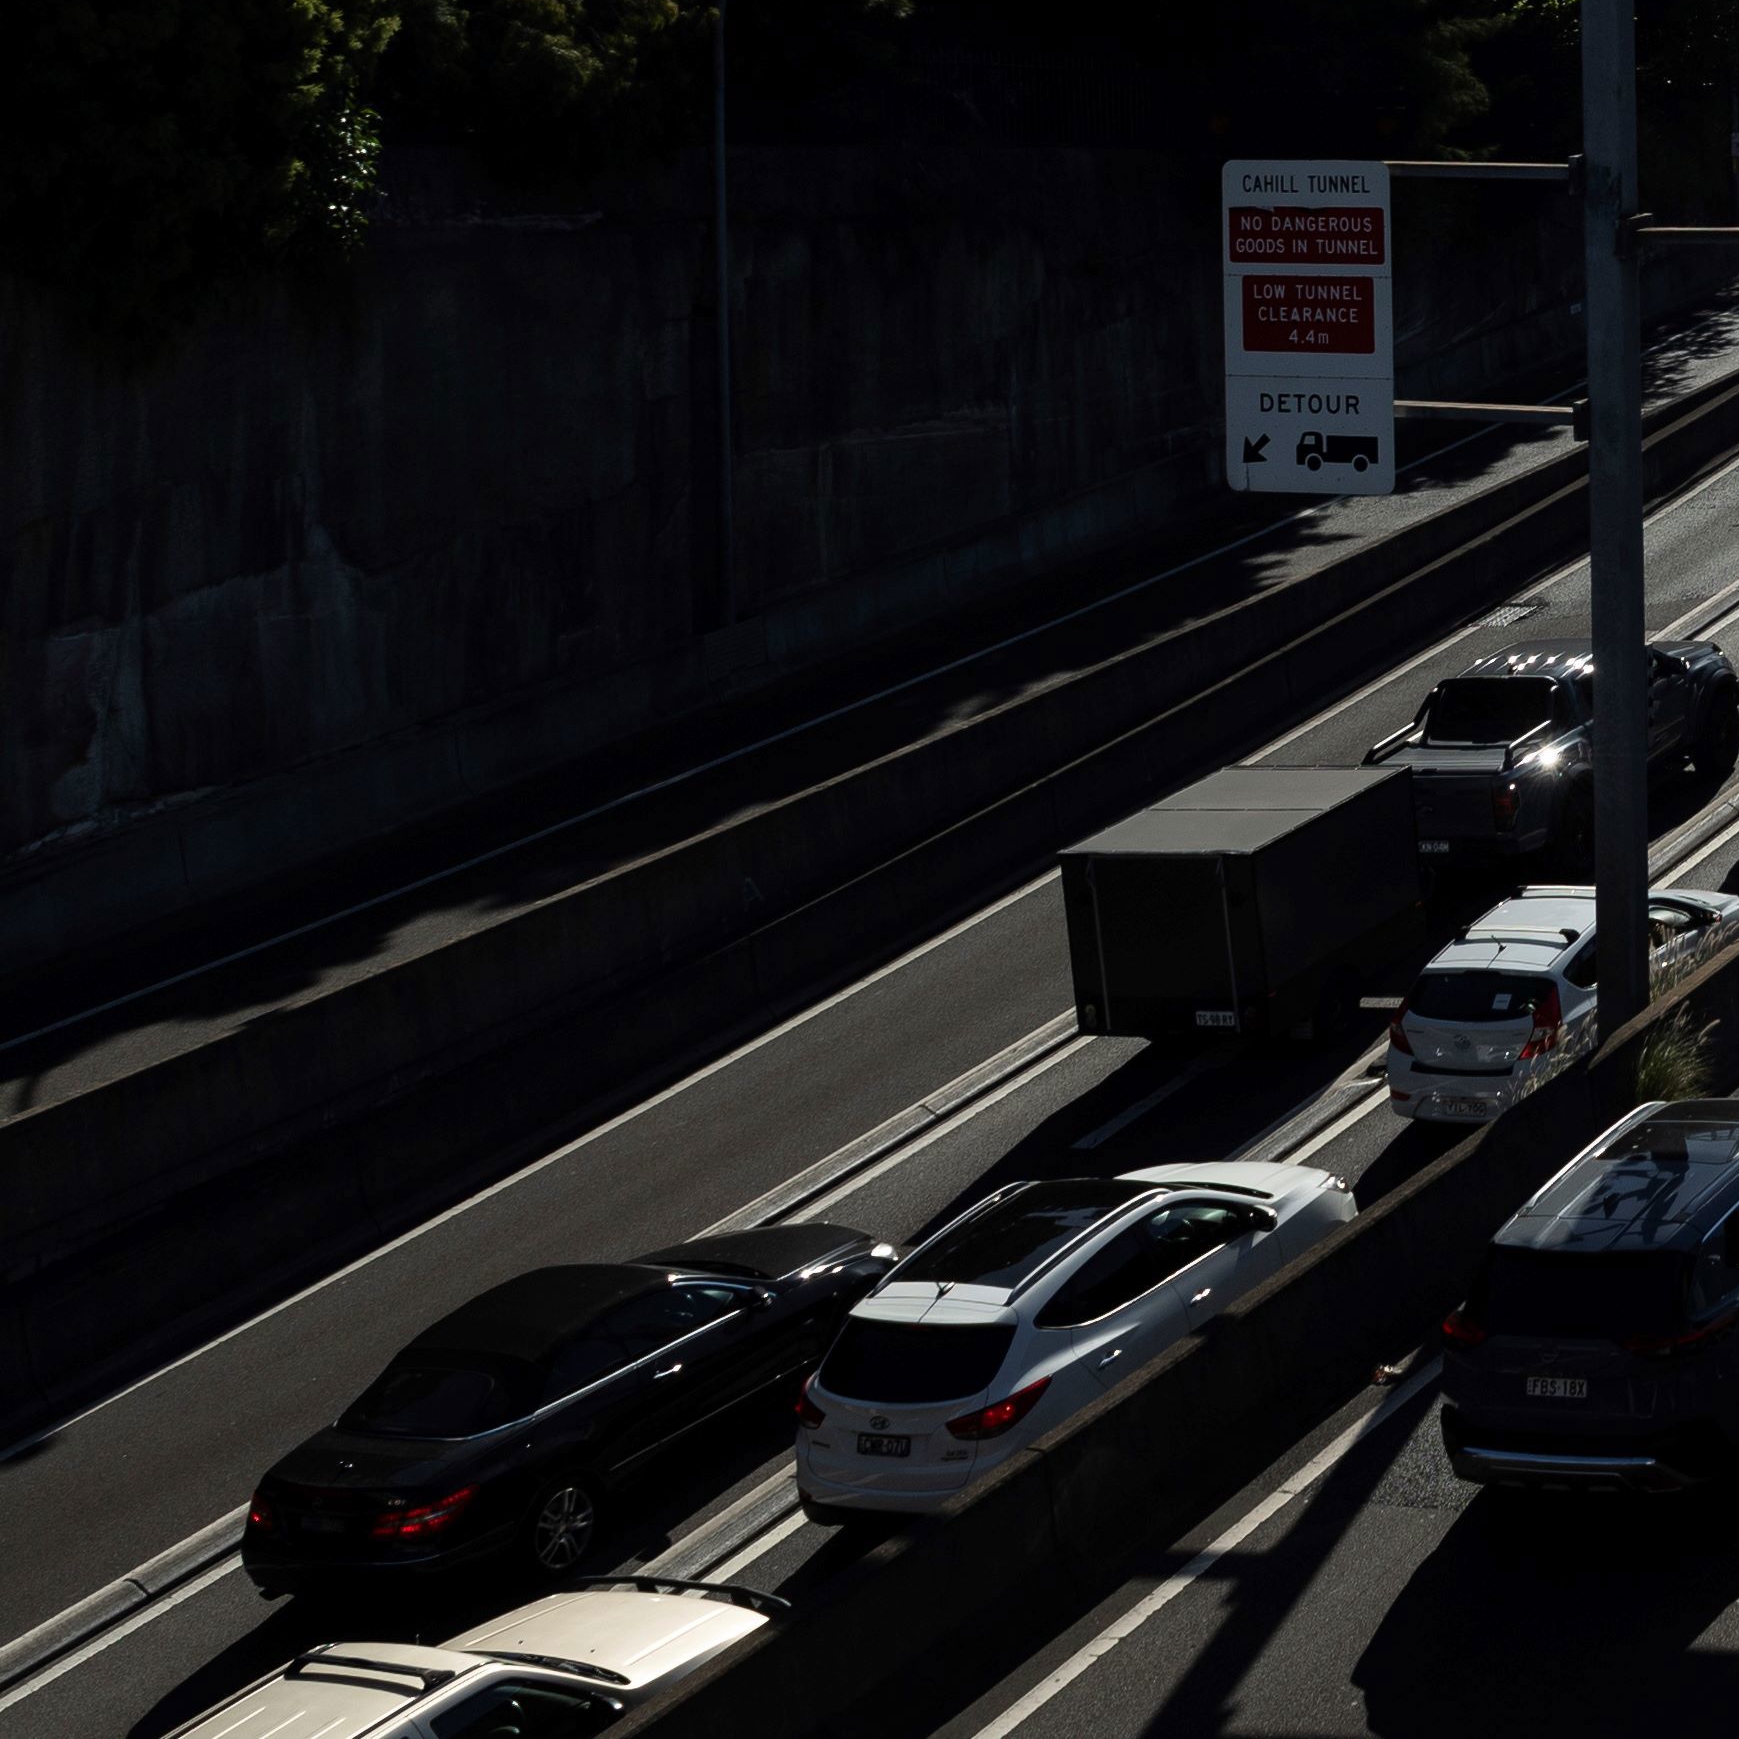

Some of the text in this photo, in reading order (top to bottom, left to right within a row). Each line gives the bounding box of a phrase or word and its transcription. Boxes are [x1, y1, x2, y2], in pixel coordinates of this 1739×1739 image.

[1242, 174, 1370, 194] CAHILL TUNNEL
[1241, 216, 1372, 233] NO DANGEROUS
[1236, 238, 1378, 255] GOODS IN TUNNEL
[1253, 284, 1362, 301] LOW TUNNEL
[1258, 306, 1358, 323] CLEARANCE
[1259, 392, 1360, 415] DETOUR
